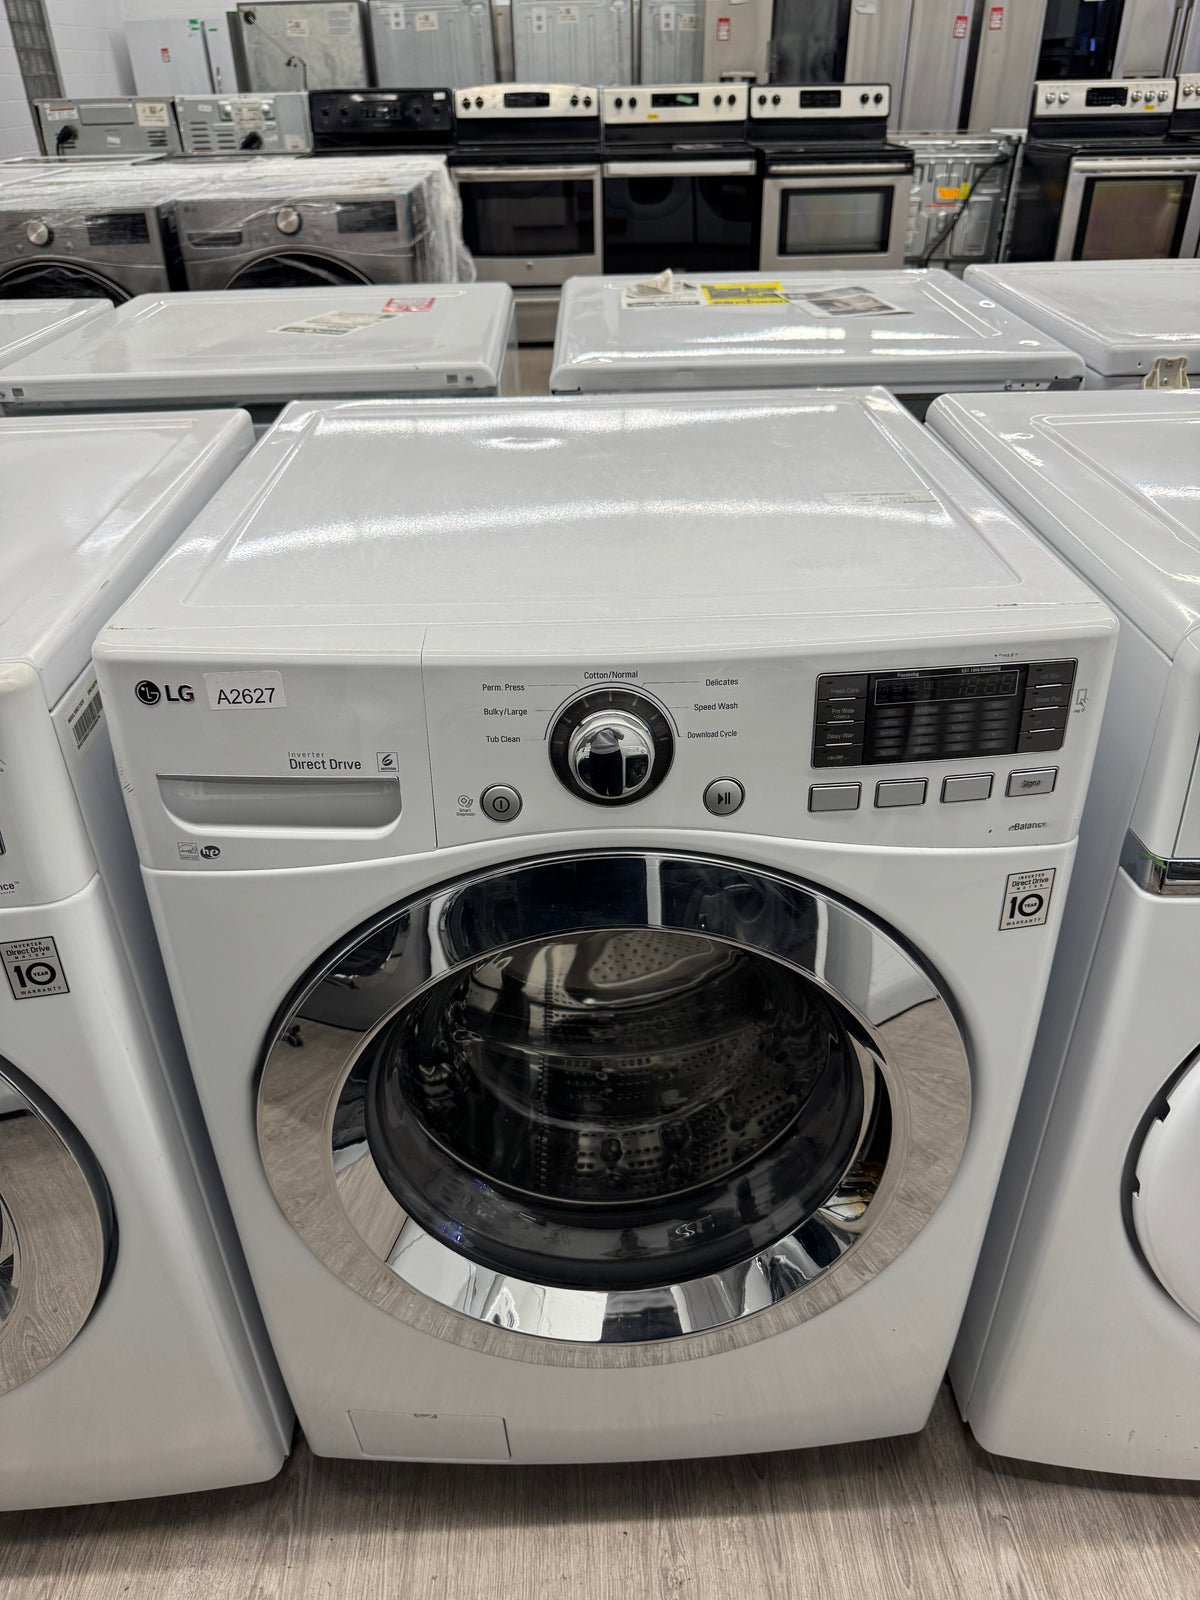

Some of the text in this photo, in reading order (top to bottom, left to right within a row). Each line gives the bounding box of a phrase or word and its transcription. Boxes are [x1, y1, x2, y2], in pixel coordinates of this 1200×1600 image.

[583, 670, 638, 680] Cotton/Normal
[705, 677, 739, 687] Delicates
[482, 683, 525, 692] Perm. Press
[165, 684, 194, 703] LG
[216, 687, 276, 705] A2627
[693, 701, 738, 712] Speed Wash
[483, 707, 528, 717] Bulky/Large
[486, 735, 521, 743] Tub Clean
[687, 730, 738, 739] Download Cycle
[289, 758, 362, 770] Direct Drive
[1012, 877, 1049, 887] Direct Drive
[1009, 893, 1044, 919] 10
[1006, 918, 1042, 926] WARRANTY
[6, 945, 51, 957] Direct Drive
[13, 962, 56, 988] 10
[20, 985, 62, 995] WARRANTY
